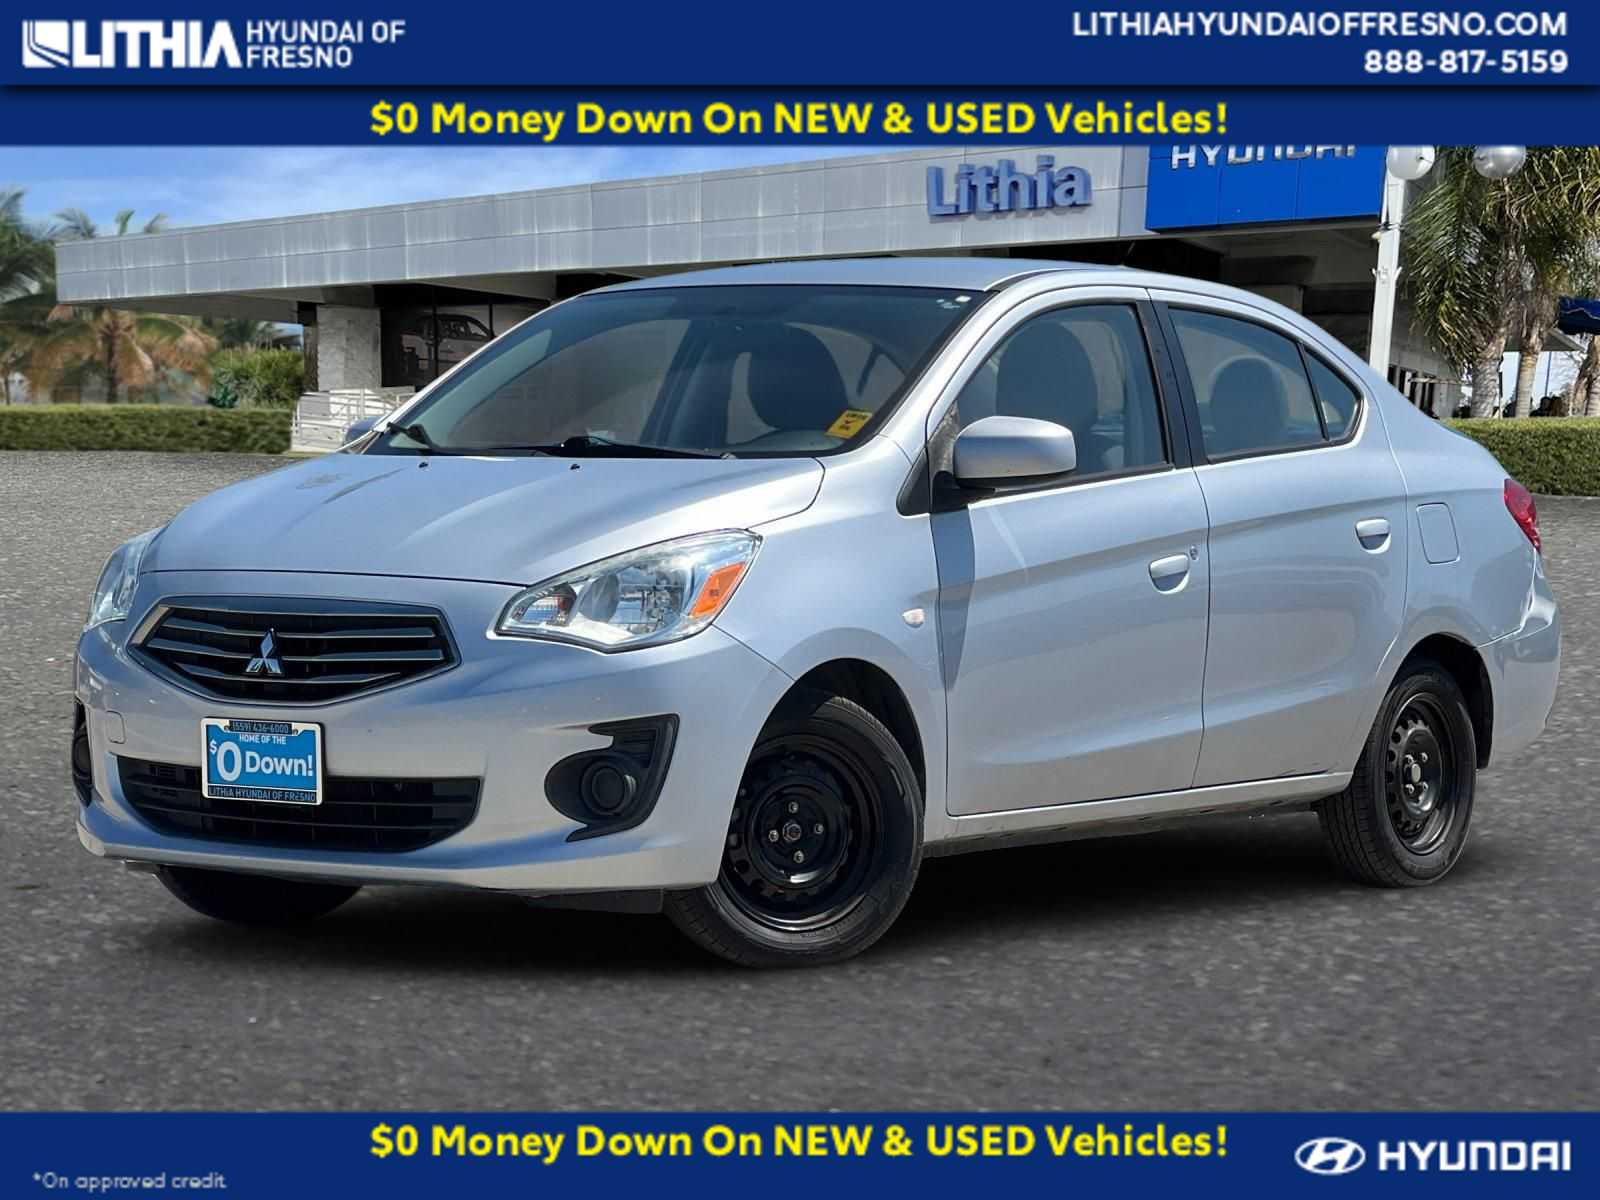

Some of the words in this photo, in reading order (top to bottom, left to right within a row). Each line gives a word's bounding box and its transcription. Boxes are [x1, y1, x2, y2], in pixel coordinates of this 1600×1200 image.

[926, 154, 1092, 216] Lithia
[239, 734, 260, 744] HOME
[261, 736, 271, 744] OF
[272, 736, 287, 745] THE
[245, 751, 314, 777] Down!
[208, 785, 234, 797] LITHIA
[235, 788, 271, 800] HYUNDAI
[272, 791, 283, 801] OF
